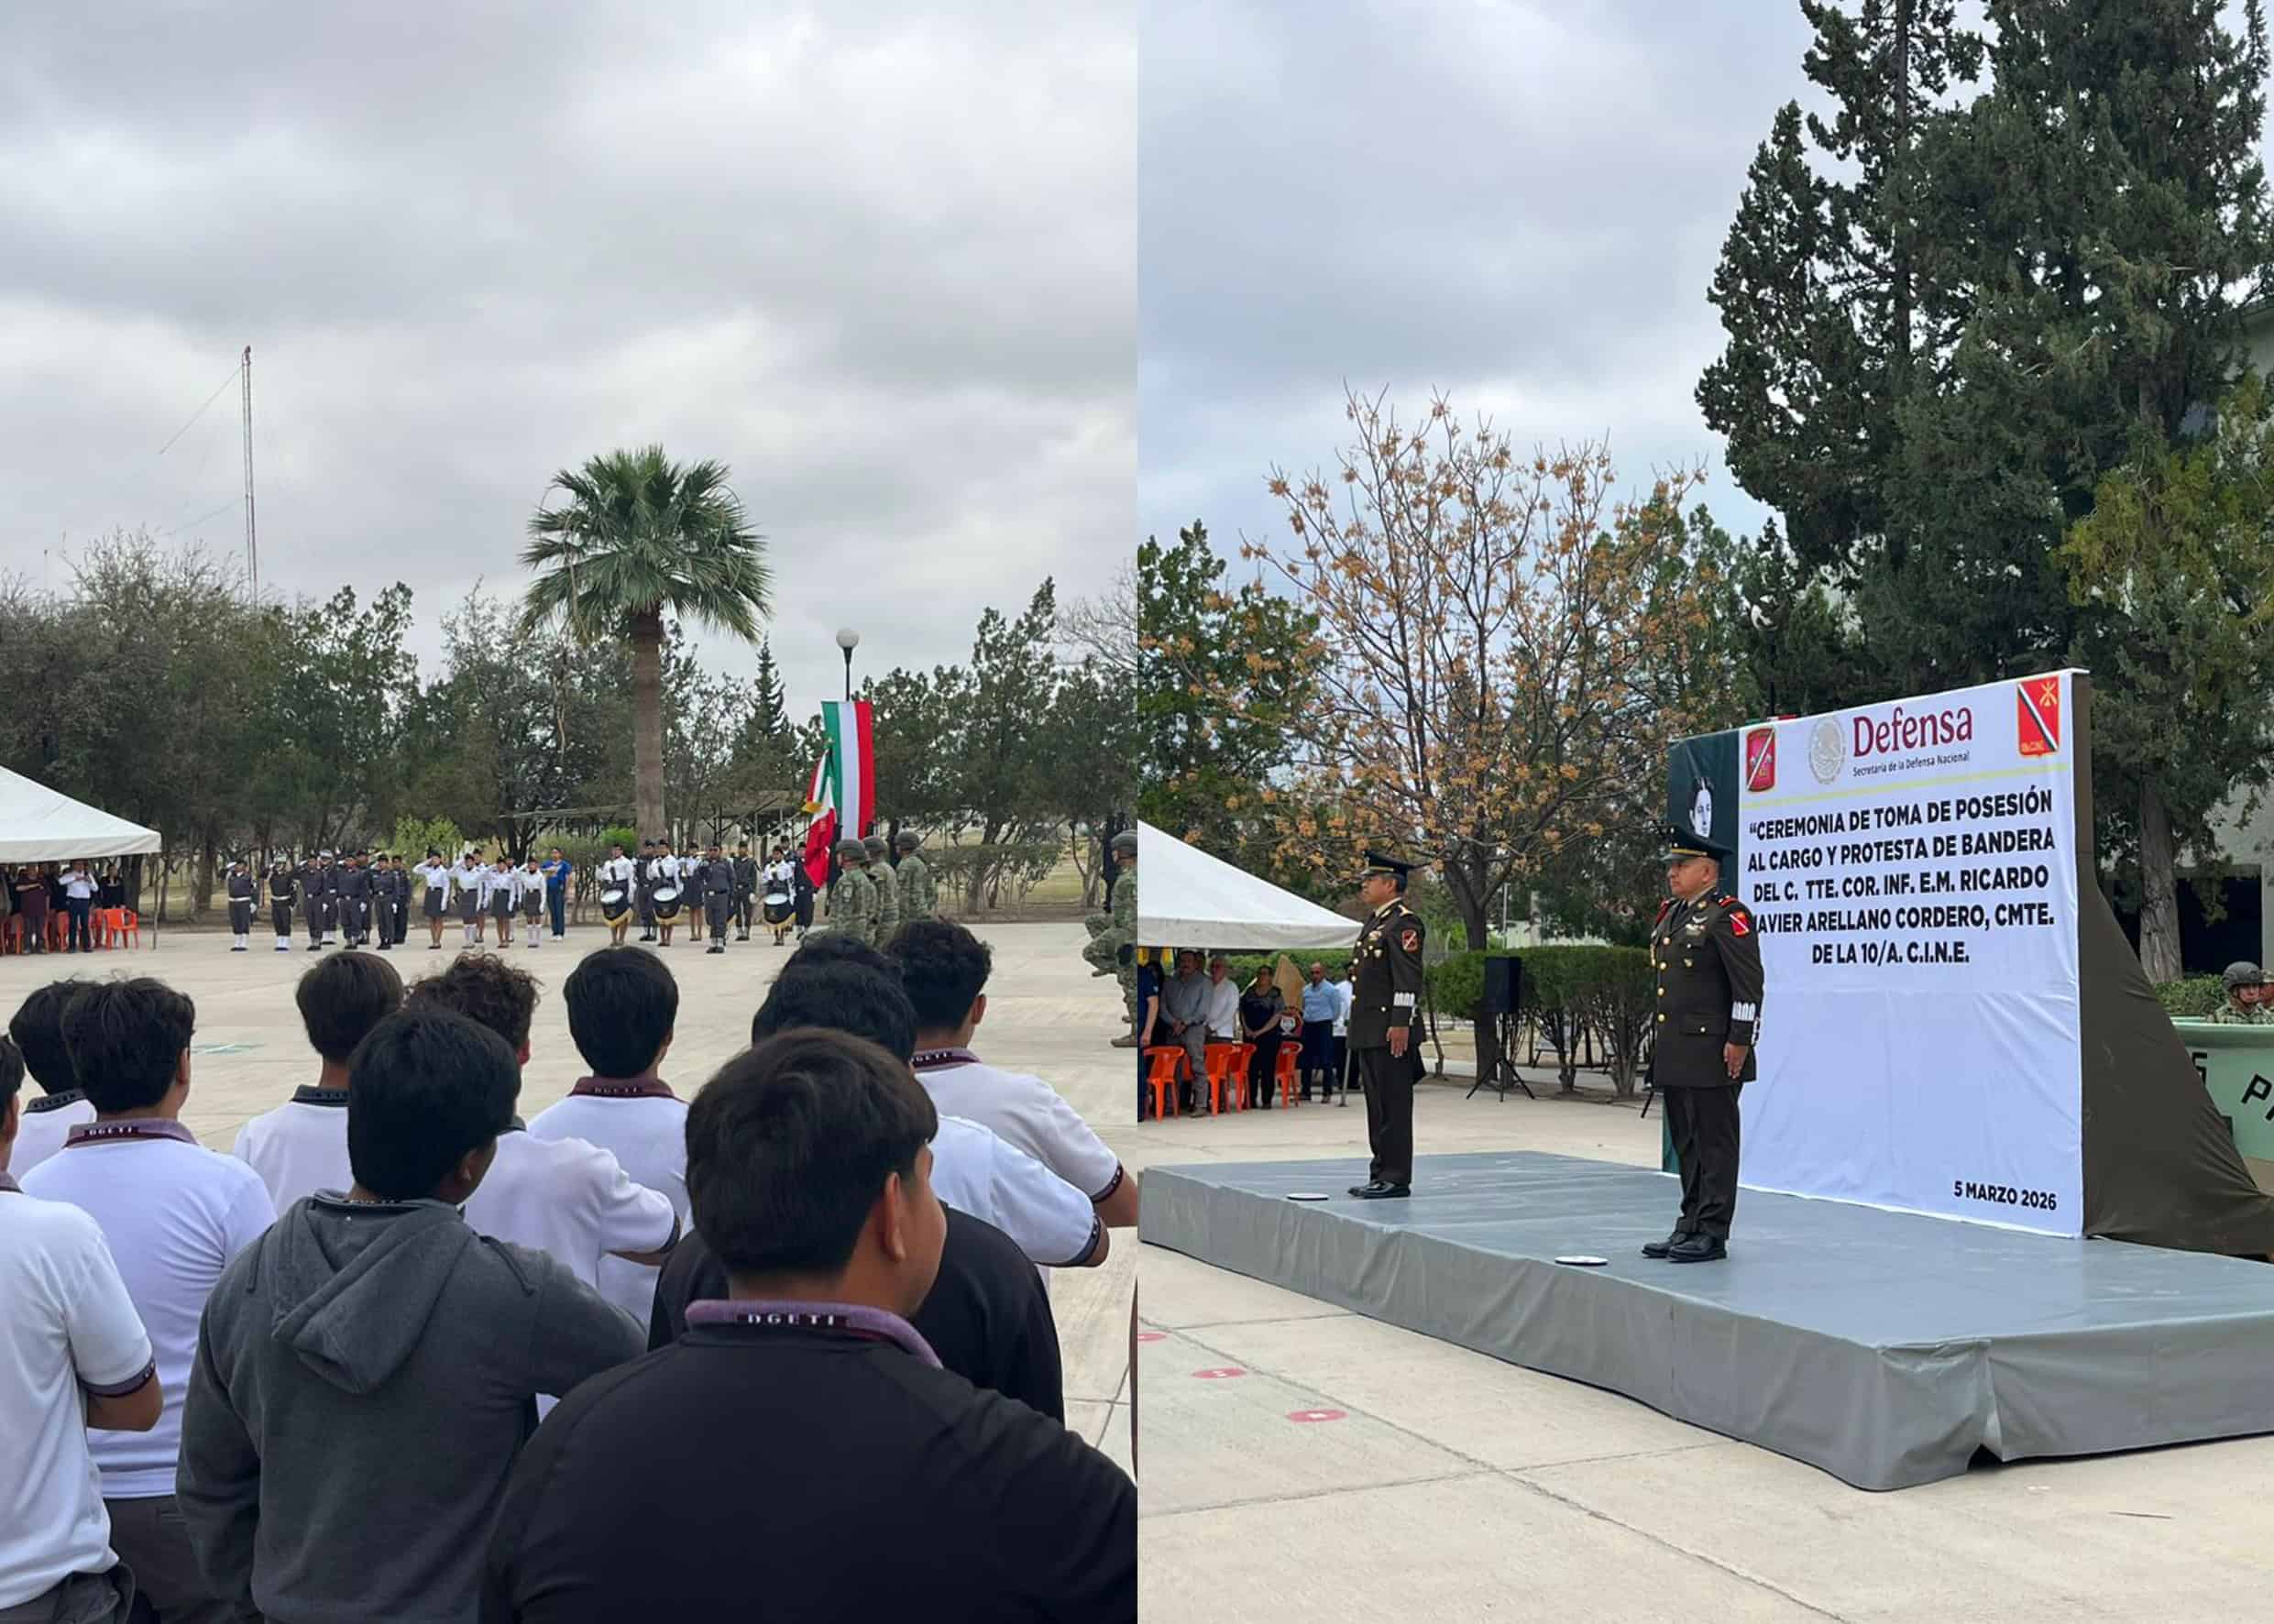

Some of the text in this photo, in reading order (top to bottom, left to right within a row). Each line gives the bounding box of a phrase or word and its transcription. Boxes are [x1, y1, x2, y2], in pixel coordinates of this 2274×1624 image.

[1853, 706, 1972, 757] Defensa
[1888, 762, 1897, 772] de
[1898, 759, 1906, 770] la
[1906, 756, 1936, 770] Defensa
[1937, 751, 1970, 765] Nacional
[1850, 809, 1871, 831] DE
[1874, 804, 1922, 828] TOMA
[1928, 801, 1951, 823] DE
[1956, 785, 2052, 820] POSESIÓN
[1748, 827, 2055, 872] AL CARGO Y PROTESTA DE BANDERA
[1753, 864, 2049, 903] DEL C. TTE. COR. INF. E.M. RICARDO
[1807, 908, 1892, 932] ARELLANO
[1895, 905, 1990, 931] CORDERO,
[1994, 902, 2055, 927] CMTE.
[1812, 939, 1970, 967] DE LA 10/A. C.I.N.E.
[1954, 1180, 2057, 1211] 5 MARZO 2026
